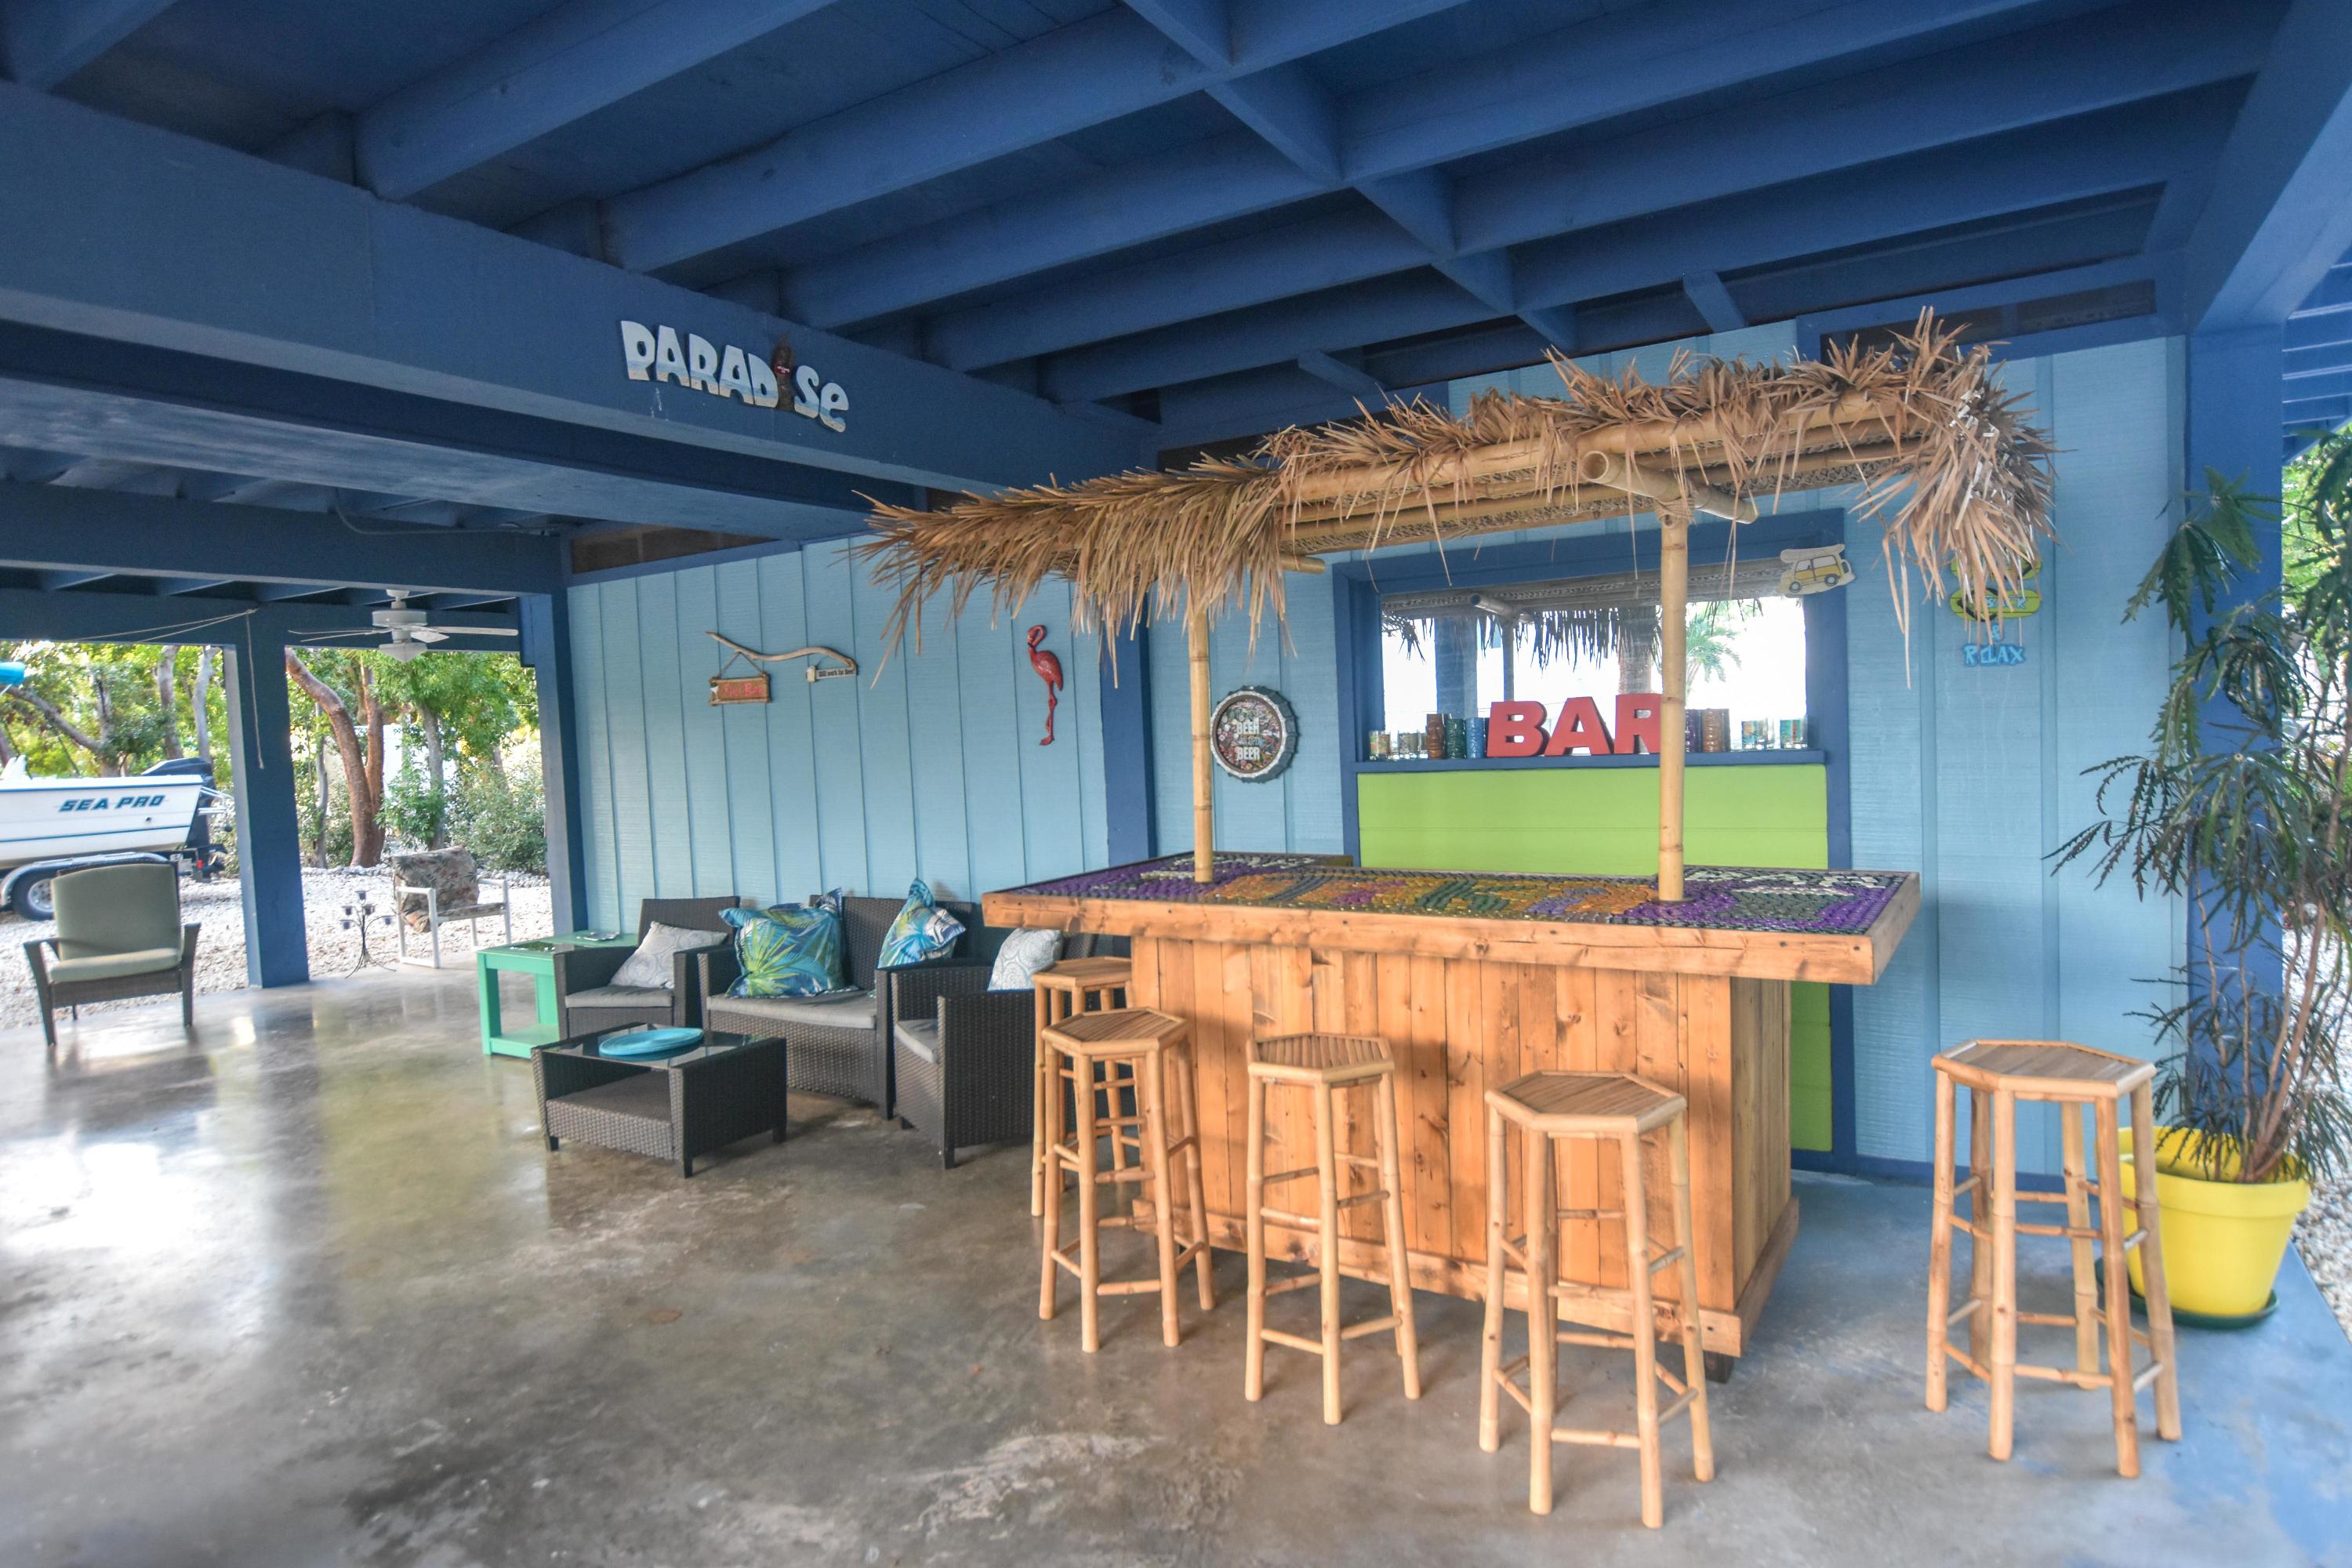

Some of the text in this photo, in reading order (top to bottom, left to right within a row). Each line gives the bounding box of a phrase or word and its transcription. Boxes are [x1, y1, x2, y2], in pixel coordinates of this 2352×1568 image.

[1236, 717, 1260, 735] BEER
[1486, 693, 1661, 757] BAR
[1237, 746, 1261, 760] BEER
[58, 795, 166, 812] SEA PRO
